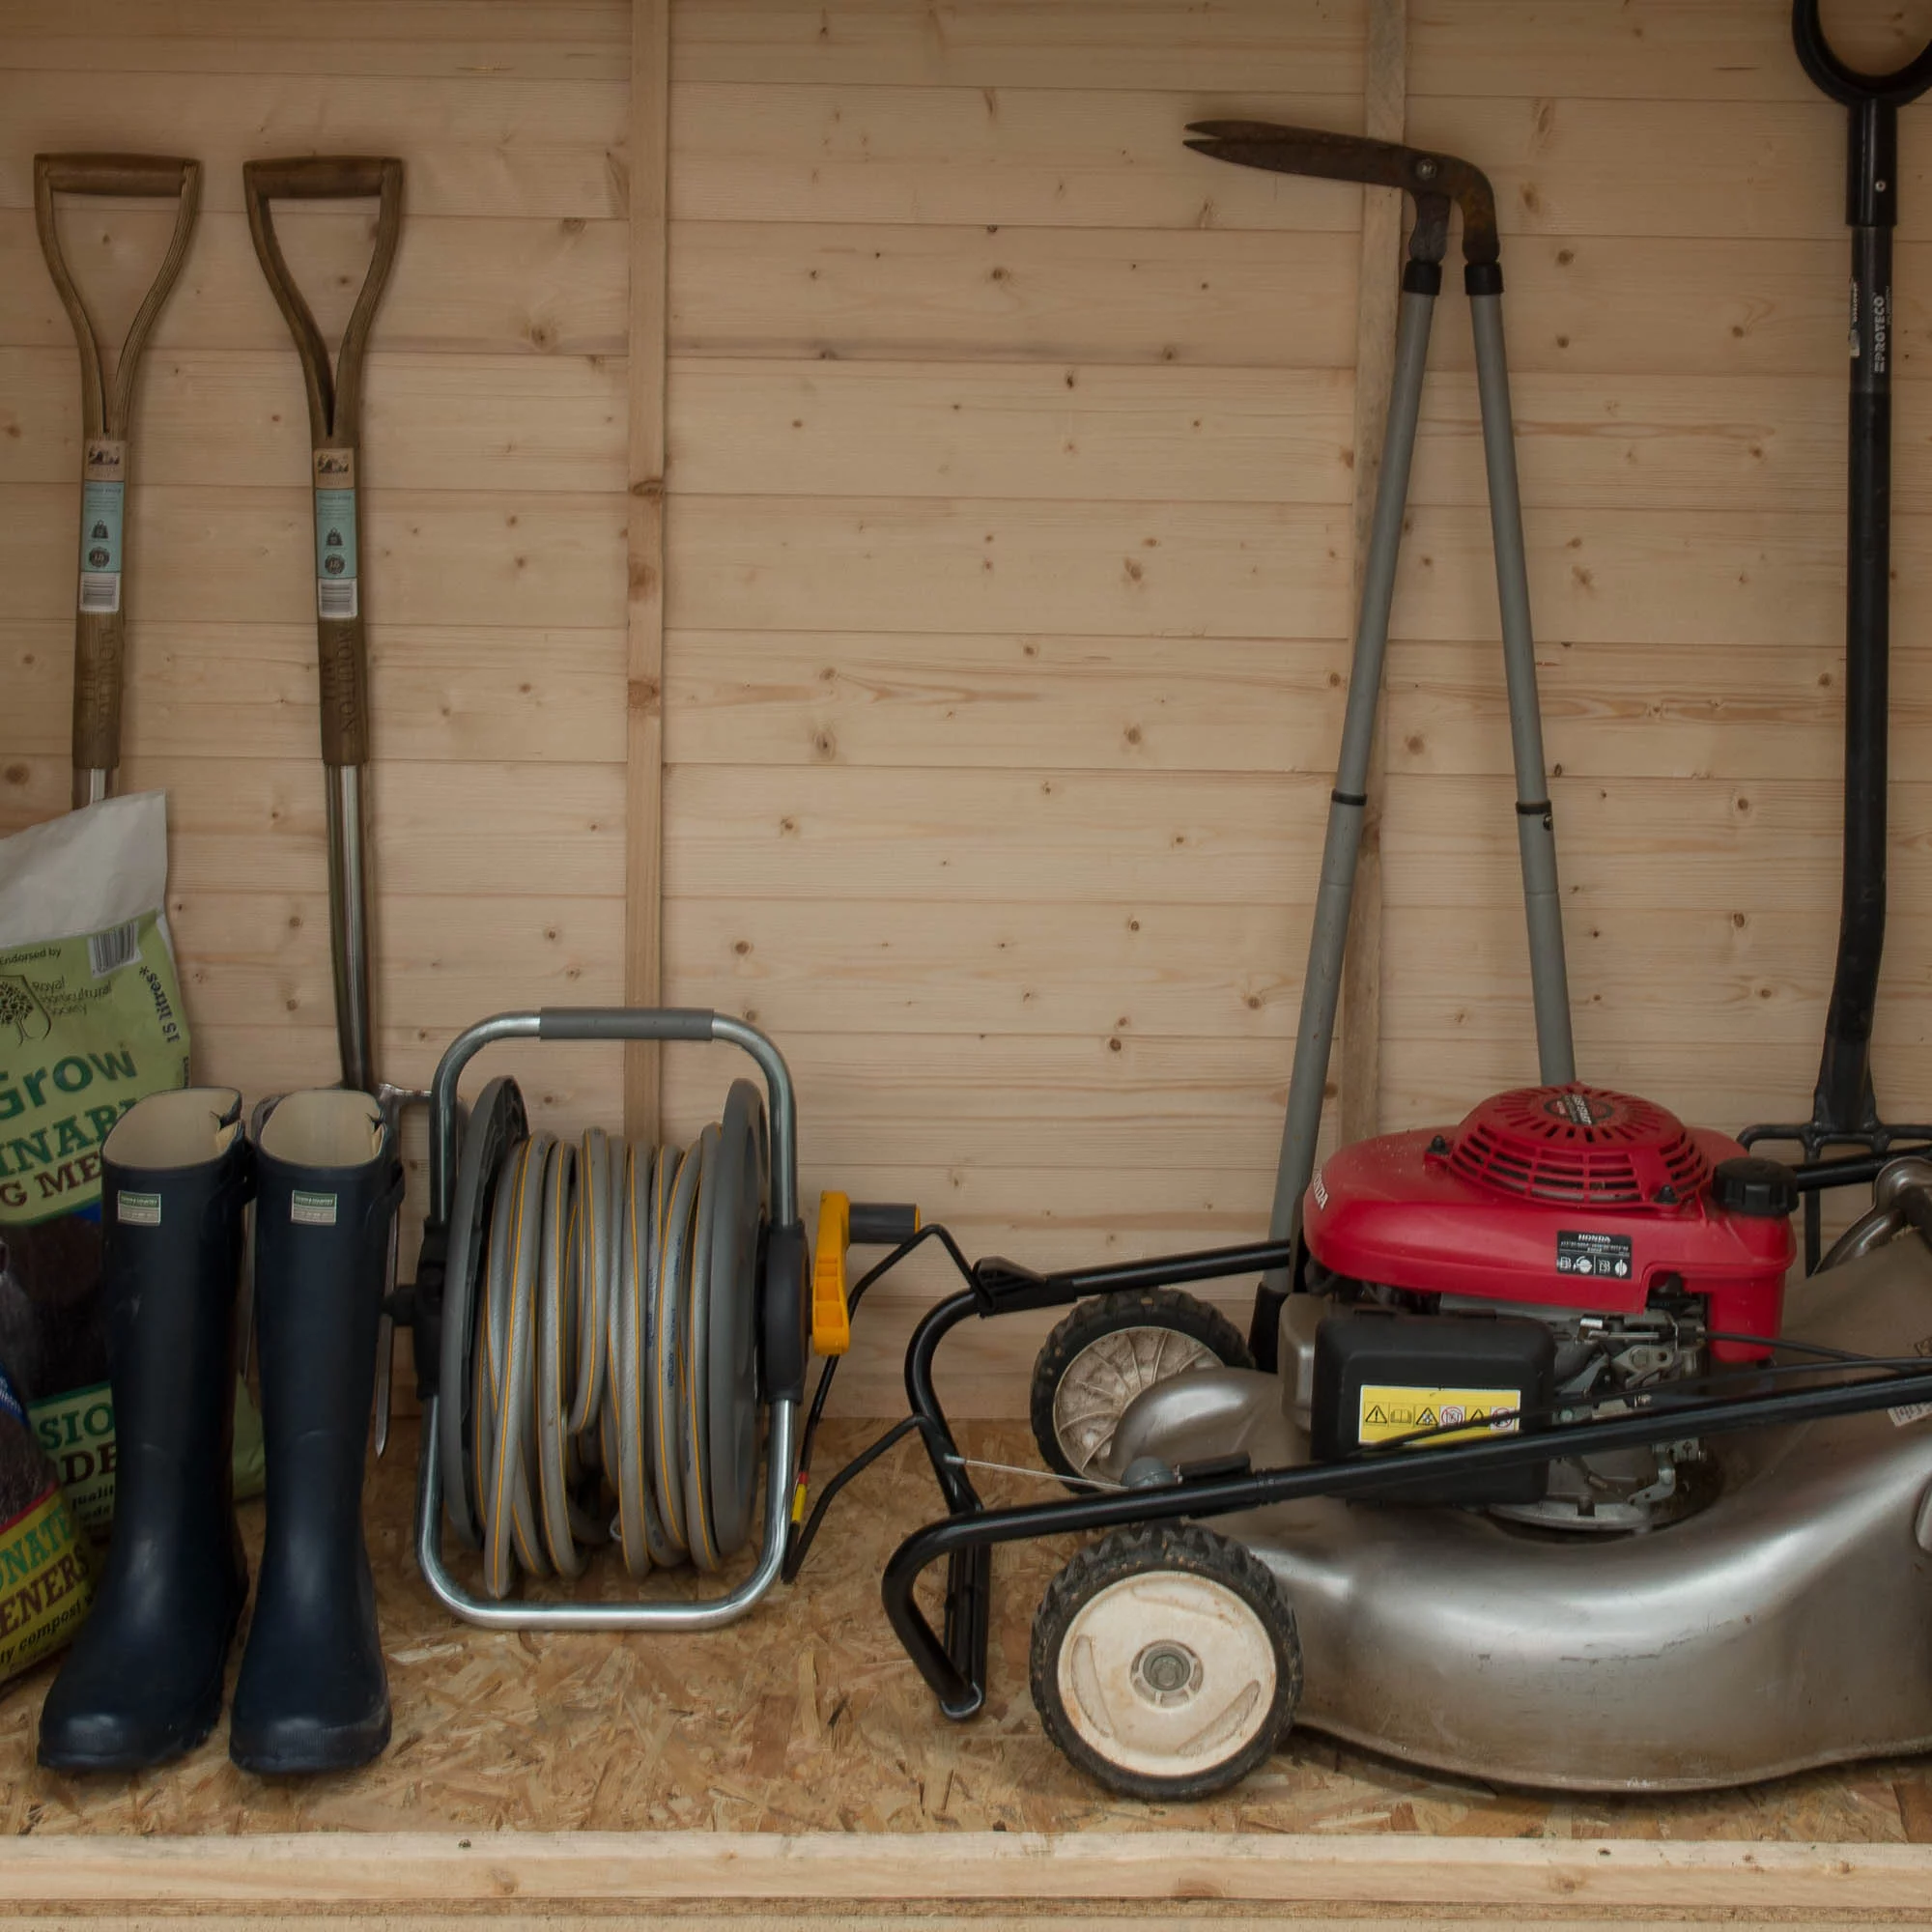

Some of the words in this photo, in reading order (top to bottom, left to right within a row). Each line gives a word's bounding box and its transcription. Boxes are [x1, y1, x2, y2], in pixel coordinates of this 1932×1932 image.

[1874, 296, 1886, 363] PROTECO
[48, 946, 62, 959] by
[161, 1022, 181, 1043] 15
[0, 1050, 137, 1121] Grow
[1577, 1233, 1611, 1244] HONDA
[0, 1505, 71, 1588] NATE
